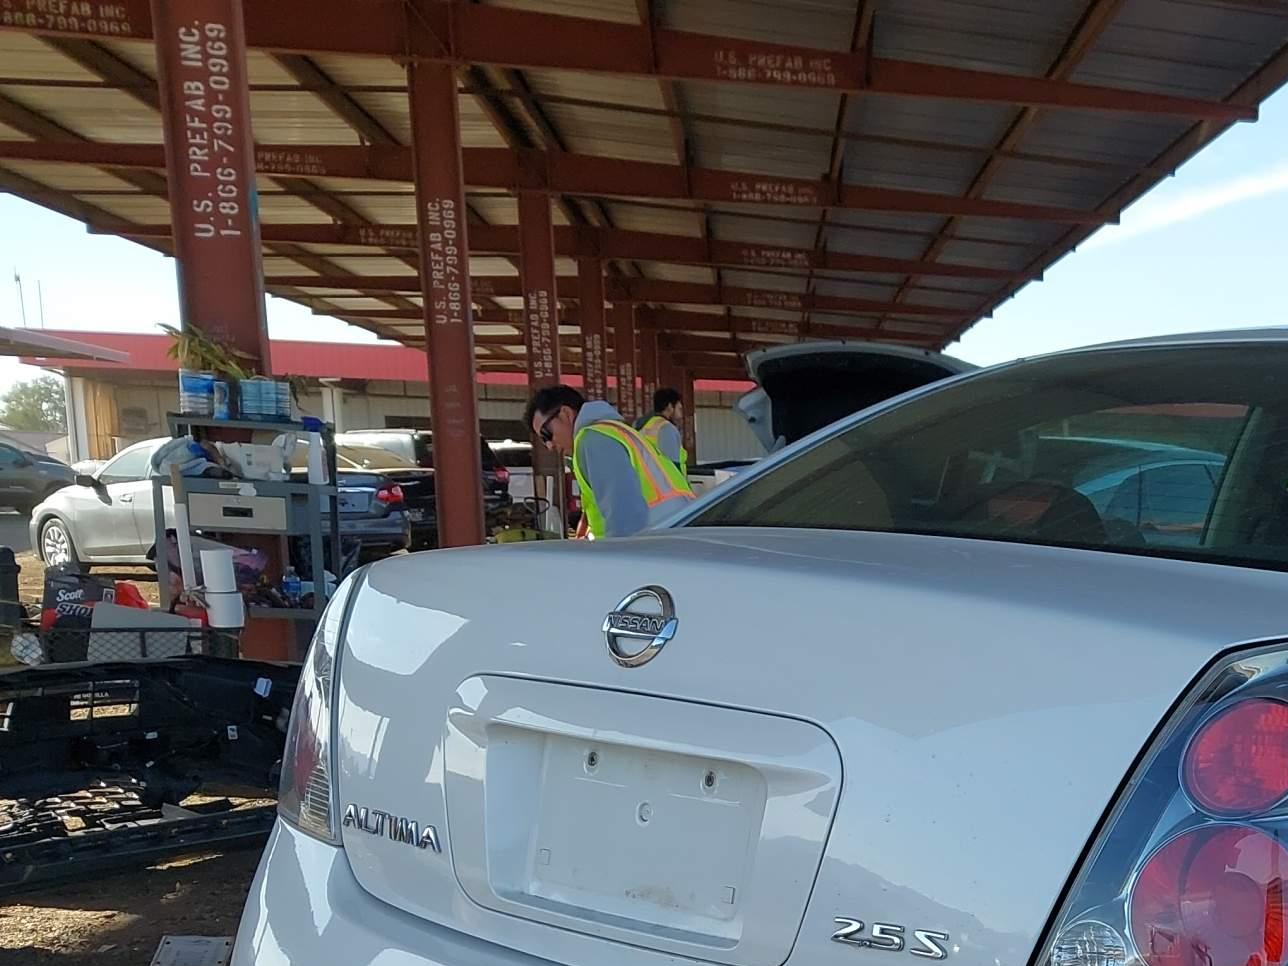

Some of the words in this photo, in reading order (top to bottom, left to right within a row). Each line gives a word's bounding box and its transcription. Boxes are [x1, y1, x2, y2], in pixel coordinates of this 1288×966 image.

[178, 20, 203, 66] INC.
[184, 80, 211, 177] PREFAB
[204, 23, 241, 236] 1-866-799-0969
[192, 192, 215, 238] U.S.
[430, 232, 446, 289] PREFAB
[56, 589, 85, 602] Scott
[607, 614, 666, 632] NISSAN
[343, 803, 442, 853] ALTIMA
[909, 929, 950, 960] S
